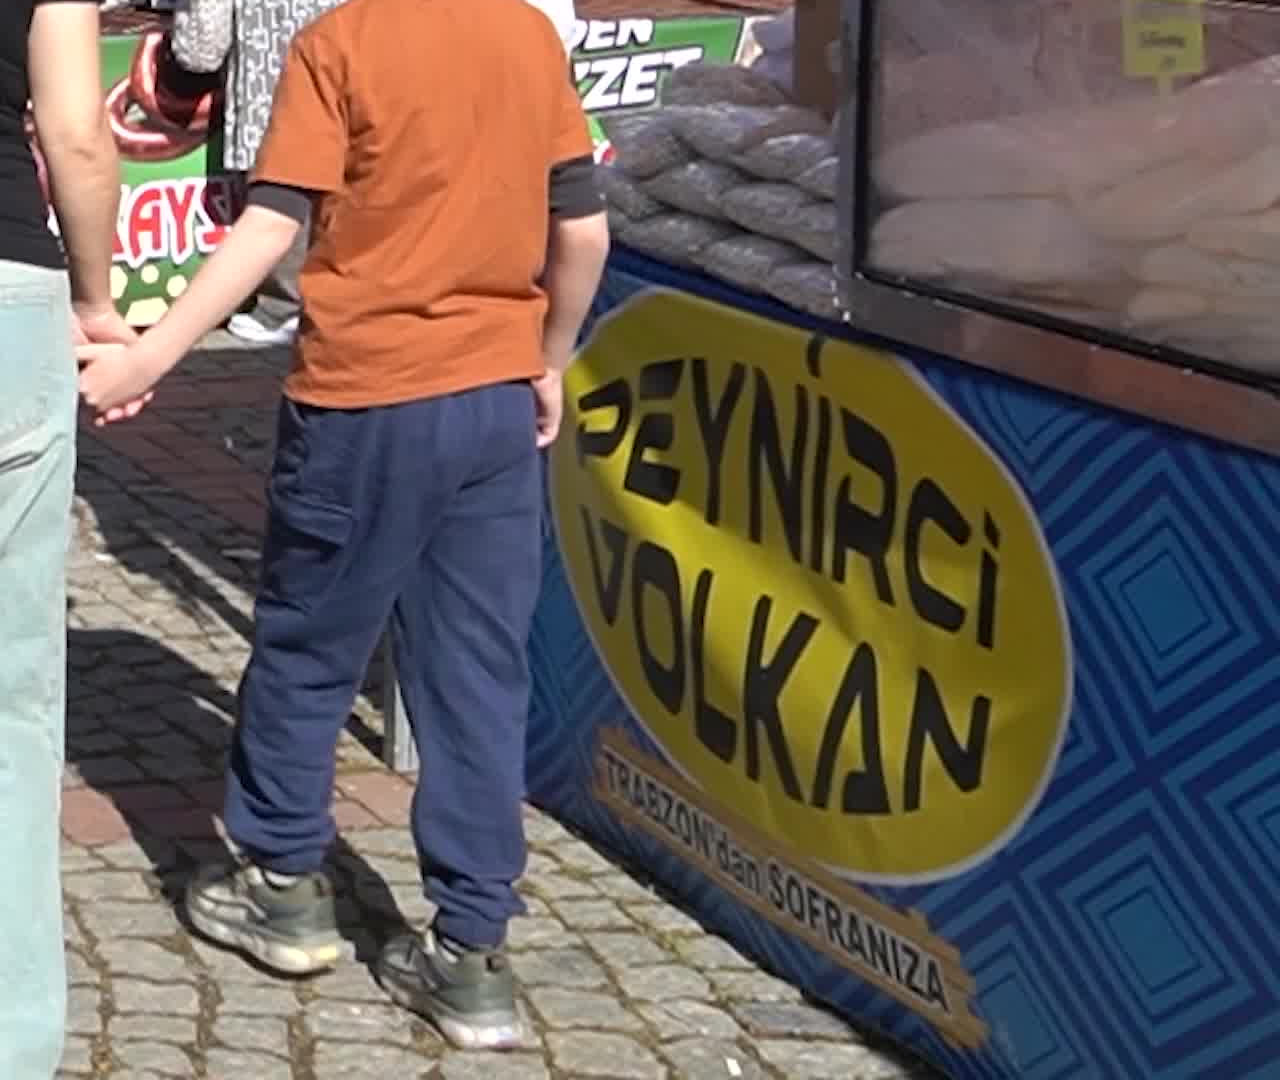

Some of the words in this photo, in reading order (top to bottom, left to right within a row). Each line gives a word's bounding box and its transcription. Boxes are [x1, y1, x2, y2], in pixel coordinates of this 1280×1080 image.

[580, 502, 993, 819] VOLKAN
[604, 748, 761, 895] TRABZON'dan
[767, 862, 951, 1012] SOFRANIZA
